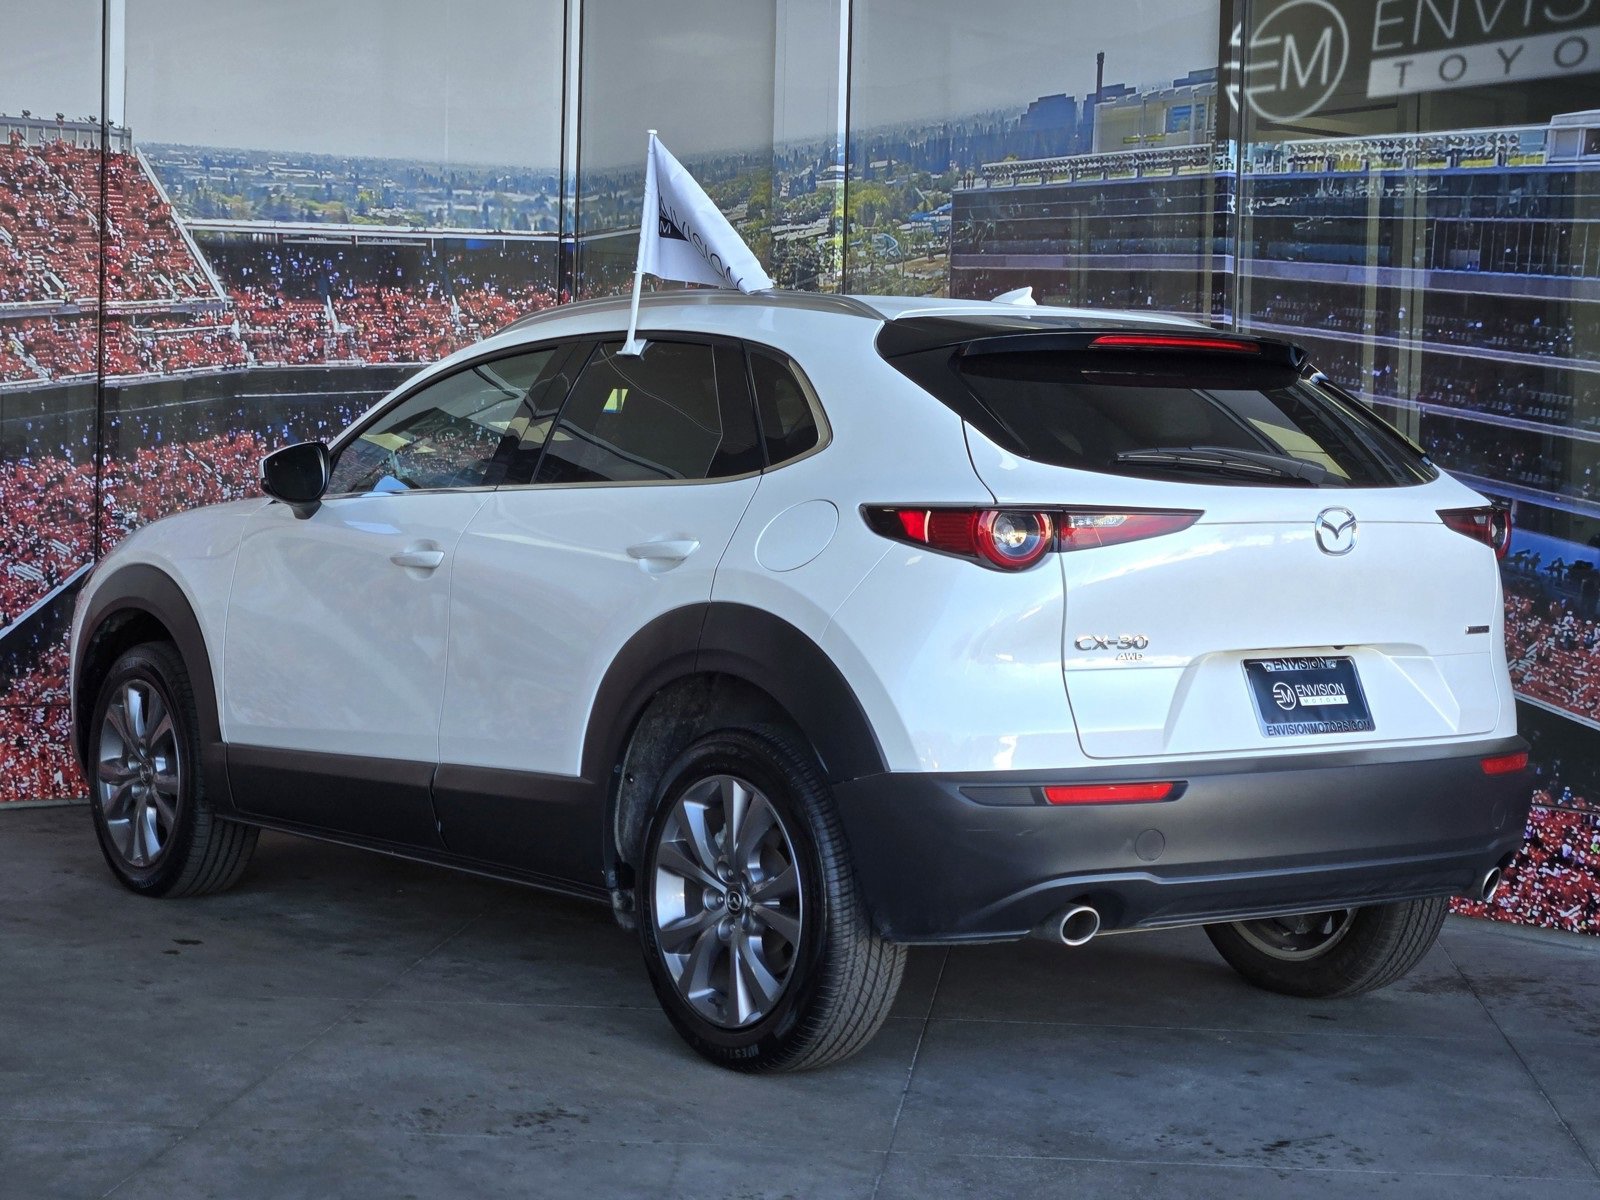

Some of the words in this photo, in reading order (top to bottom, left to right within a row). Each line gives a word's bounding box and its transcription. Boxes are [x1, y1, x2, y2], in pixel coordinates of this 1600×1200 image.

[1393, 36, 1589, 88] TOYO
[1074, 635, 1149, 651] CX-30
[1115, 652, 1144, 661] AWD
[1273, 657, 1328, 671] ENVISION
[1295, 683, 1346, 697] ENVISION
